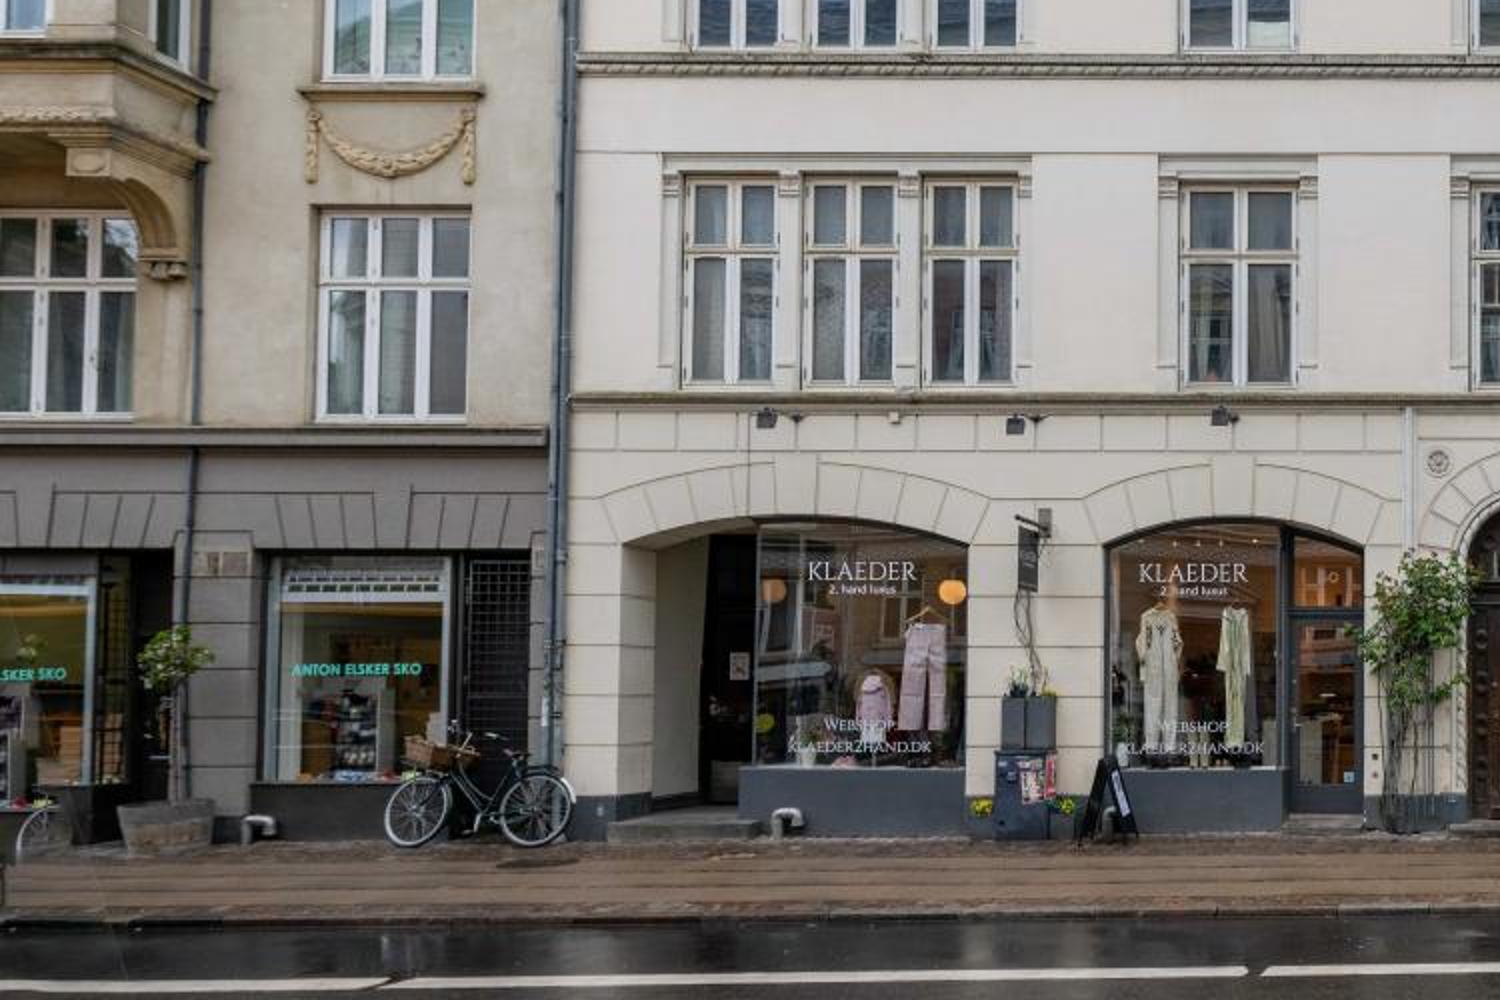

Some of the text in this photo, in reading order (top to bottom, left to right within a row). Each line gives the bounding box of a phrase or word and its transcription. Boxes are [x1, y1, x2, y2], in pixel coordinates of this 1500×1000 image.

[808, 561, 918, 581] KLAEDER
[1138, 563, 1249, 583] KLAEDER
[841, 584, 867, 595] hand
[38, 667, 67, 681] SKO
[291, 663, 422, 676] ANTON ELSKER SKO
